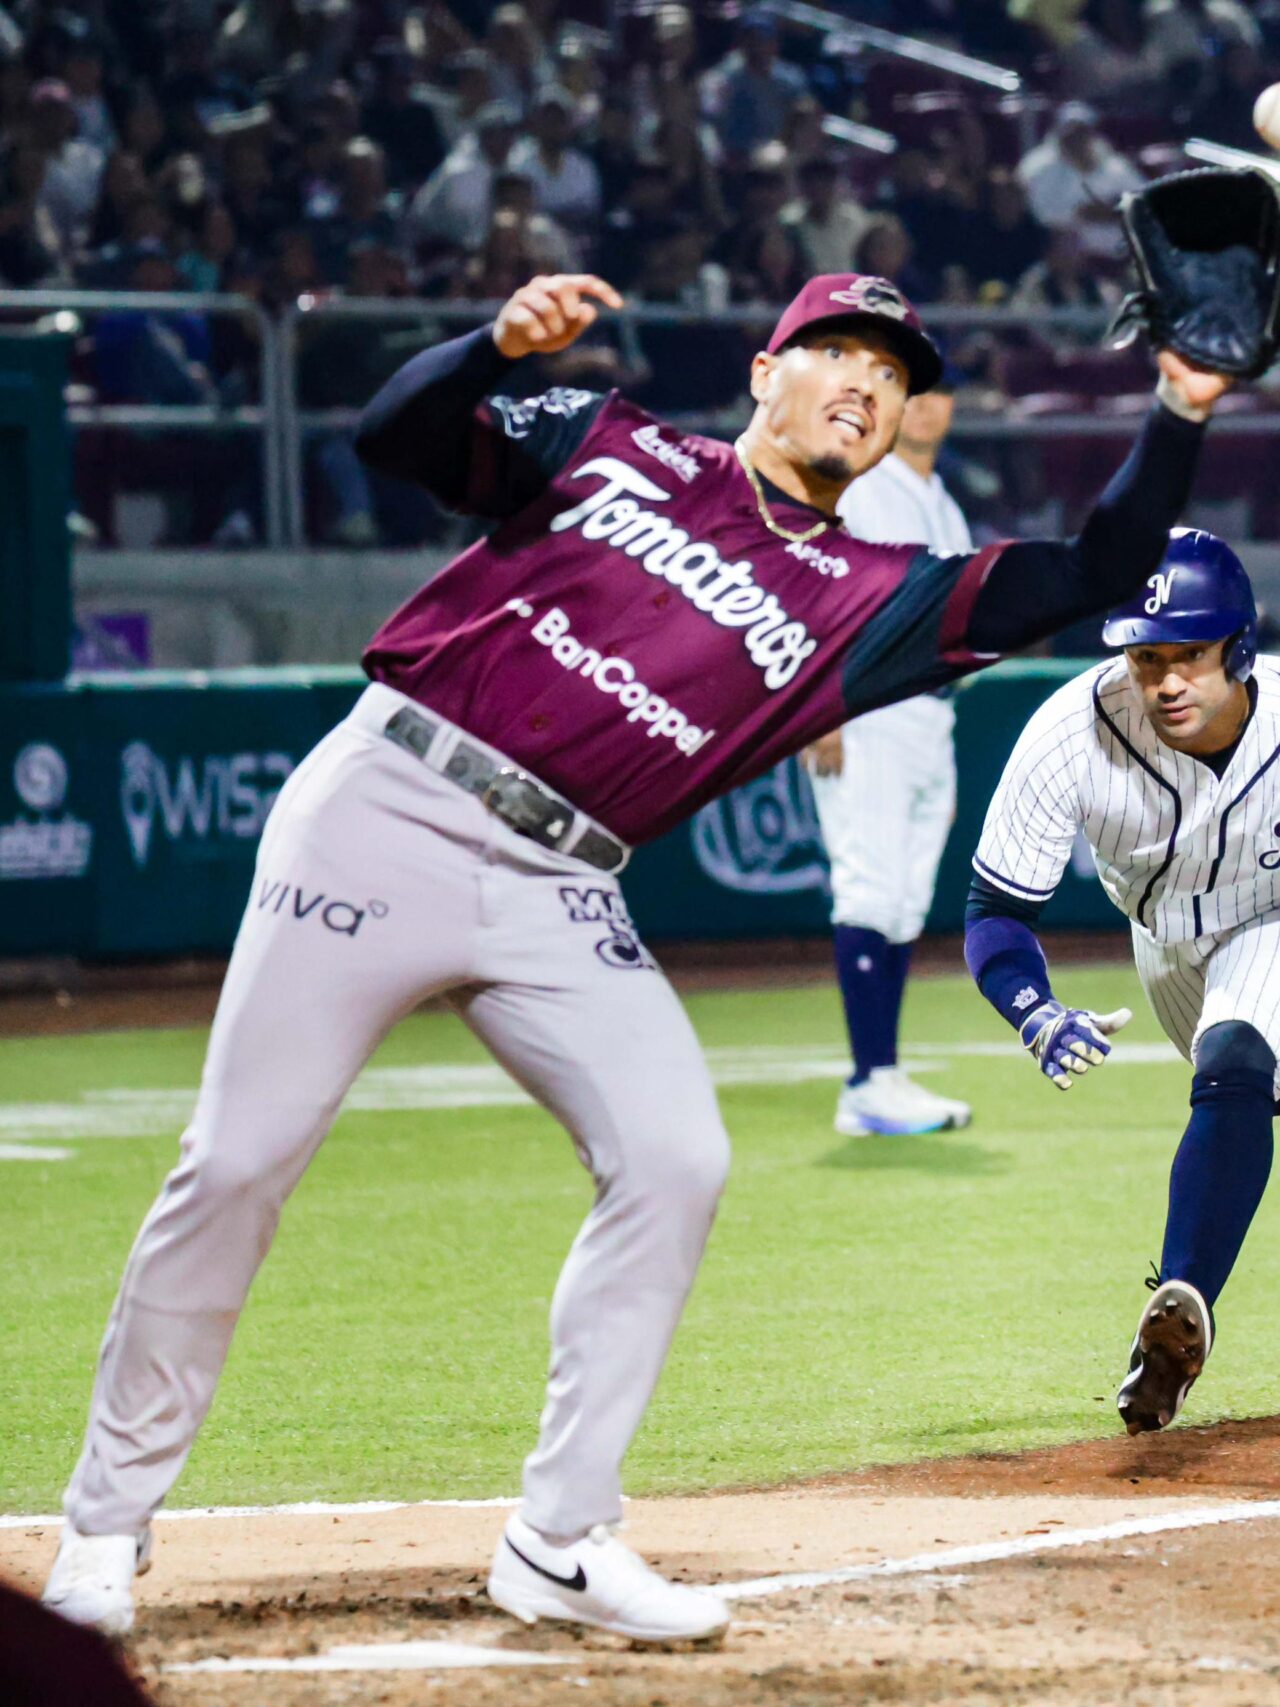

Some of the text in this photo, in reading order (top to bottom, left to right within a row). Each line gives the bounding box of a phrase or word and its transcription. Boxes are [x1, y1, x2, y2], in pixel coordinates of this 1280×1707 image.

[549, 457, 817, 689] Tomateros
[1144, 568, 1176, 615] N
[530, 606, 716, 757] BanCoppel
